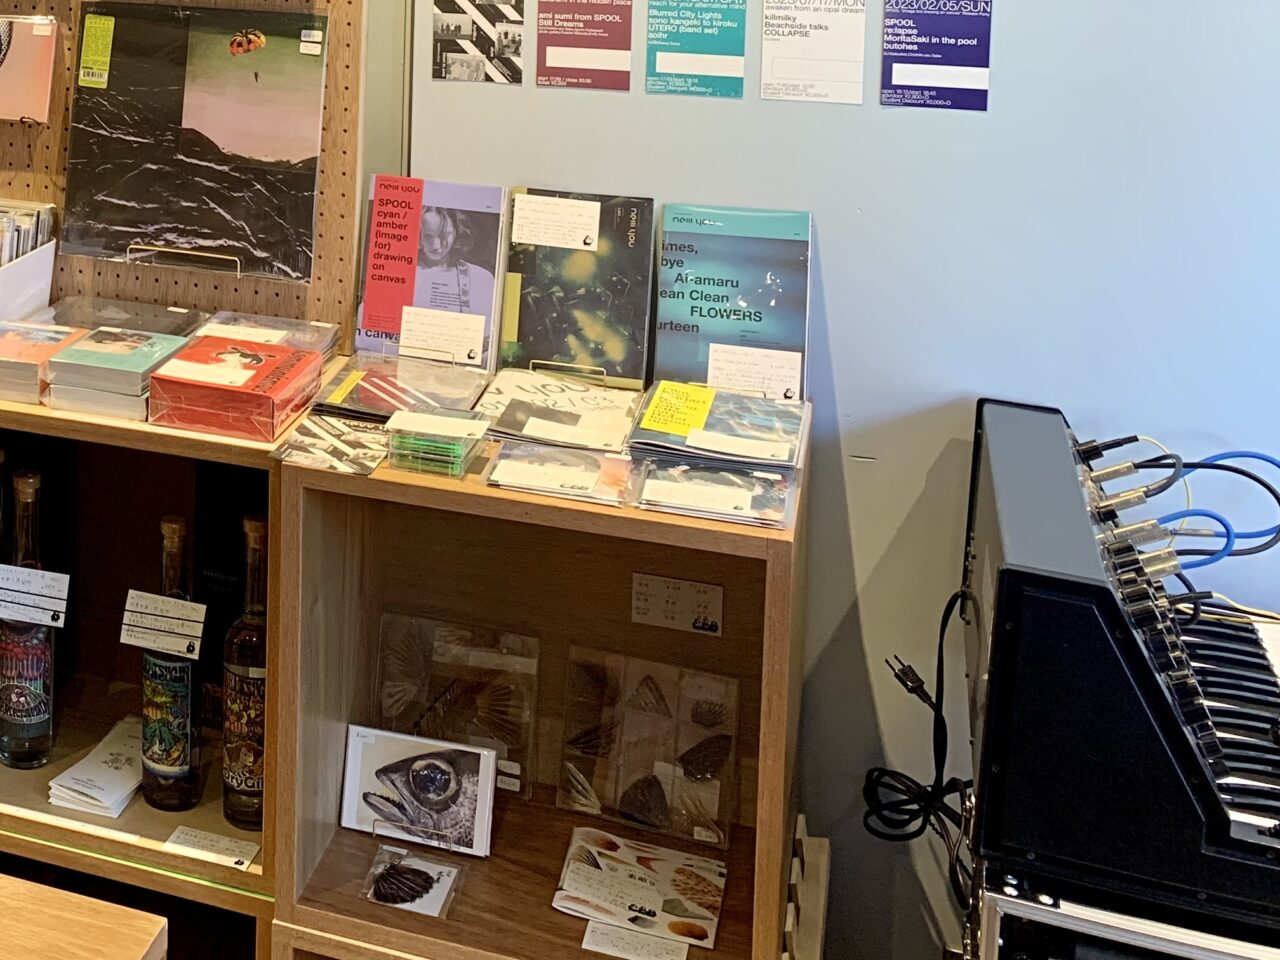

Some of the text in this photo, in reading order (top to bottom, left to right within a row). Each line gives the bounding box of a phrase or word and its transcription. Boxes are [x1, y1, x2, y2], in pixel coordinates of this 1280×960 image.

[886, 0, 991, 12] 2023/02/05/SUN
[594, 14, 622, 22] SPOOL
[649, 9, 722, 19] Blurred City Lights
[764, 14, 797, 23] killmilky
[554, 19, 584, 27] Dreams
[884, 19, 916, 27] SPOOL
[649, 24, 718, 35] UTERO (band set)
[764, 29, 810, 37] COLLAPSE
[884, 35, 929, 43] MoritaSaki
[958, 38, 977, 46] pool
[378, 199, 413, 210] SPOOL
[377, 211, 401, 220] cyan
[376, 221, 408, 230] amber
[375, 230, 408, 241] (image
[374, 241, 391, 250] for)
[373, 252, 413, 265] drawing
[660, 256, 684, 269] bye
[371, 274, 406, 284] canvas
[674, 273, 739, 288] Ai-amaru
[660, 290, 729, 303] ean Clean
[690, 306, 763, 322] FLOWERS
[365, 329, 400, 340] canva
